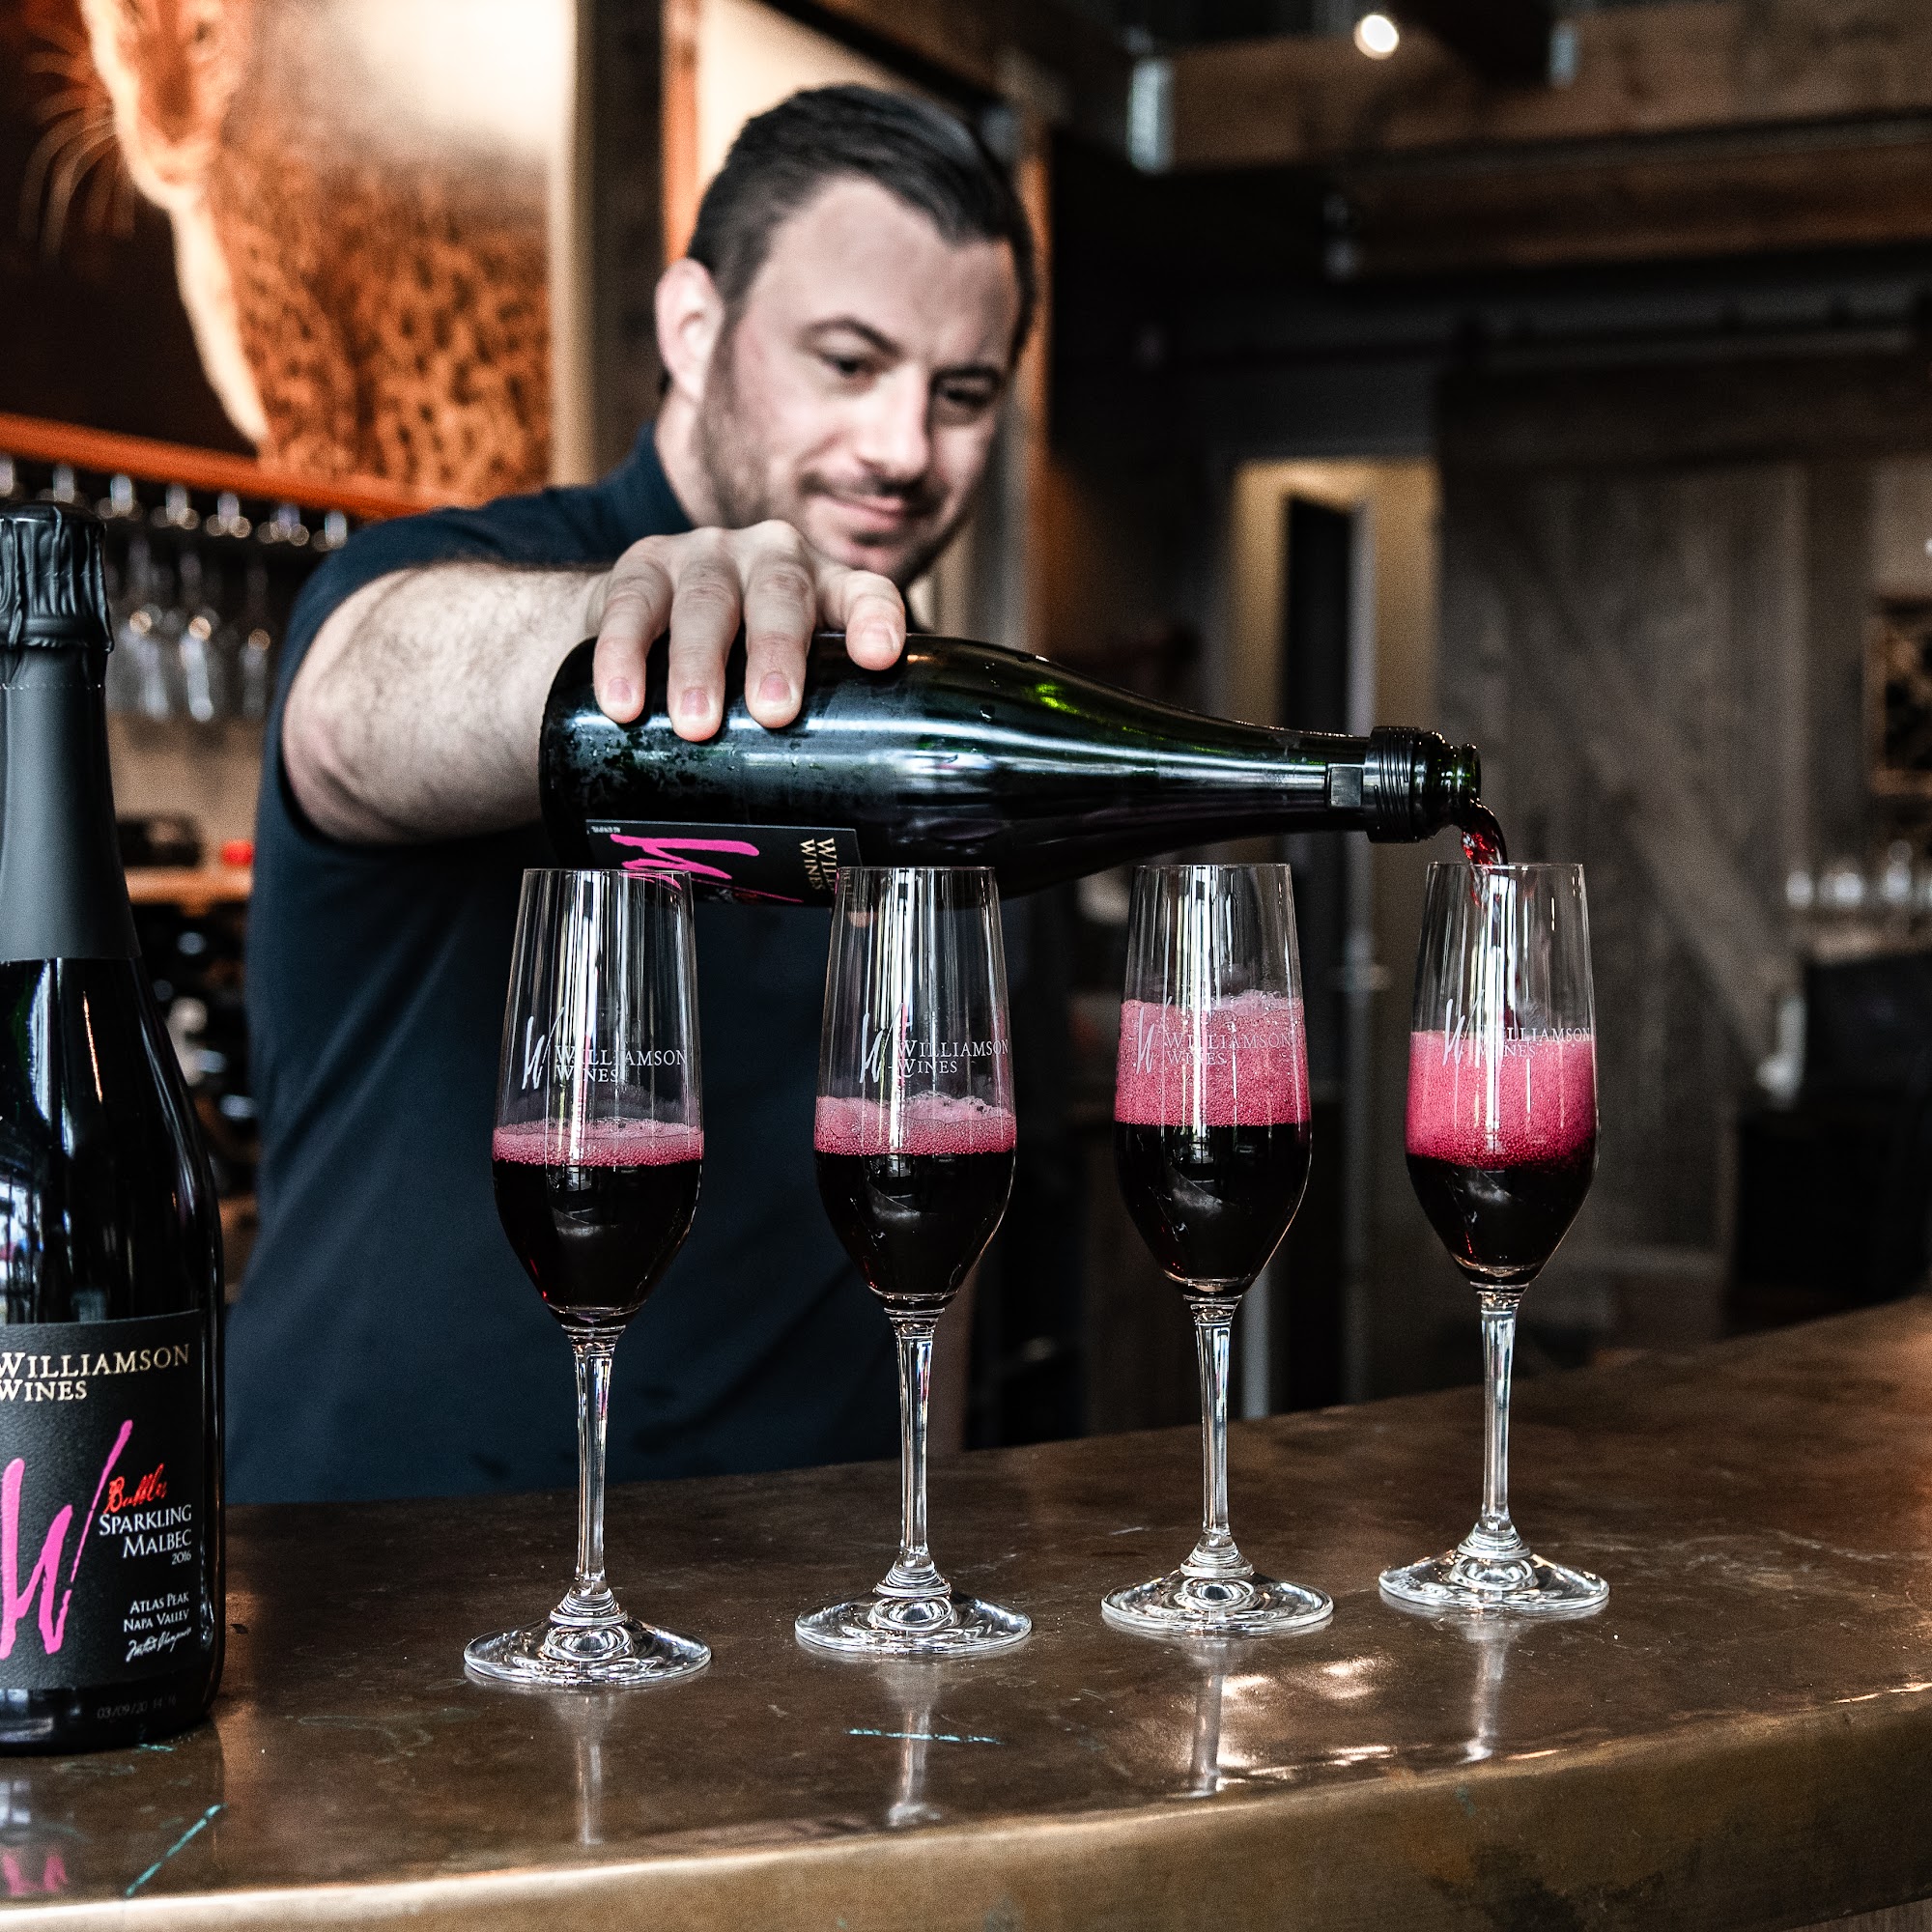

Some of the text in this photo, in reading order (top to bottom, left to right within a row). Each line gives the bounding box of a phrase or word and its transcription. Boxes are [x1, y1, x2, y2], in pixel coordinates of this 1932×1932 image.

[895, 1038, 1009, 1058] WILLIAMSON
[1164, 1033, 1293, 1050] WILLIAMSON
[1478, 1043, 1536, 1058] WNES
[554, 1045, 688, 1066] WILLIAMSON
[556, 1065, 619, 1083] WINES
[897, 1059, 958, 1074] WINES
[0, 1344, 189, 1379] WILLIAMSON
[0, 1378, 88, 1402] WINES
[99, 1504, 192, 1536] SPARKLING
[122, 1528, 192, 1559] MALBEC
[171, 1549, 192, 1566] 2016
[128, 1591, 190, 1615] ATLAS PEAK
[123, 1608, 190, 1633] NAPA VALLEY
